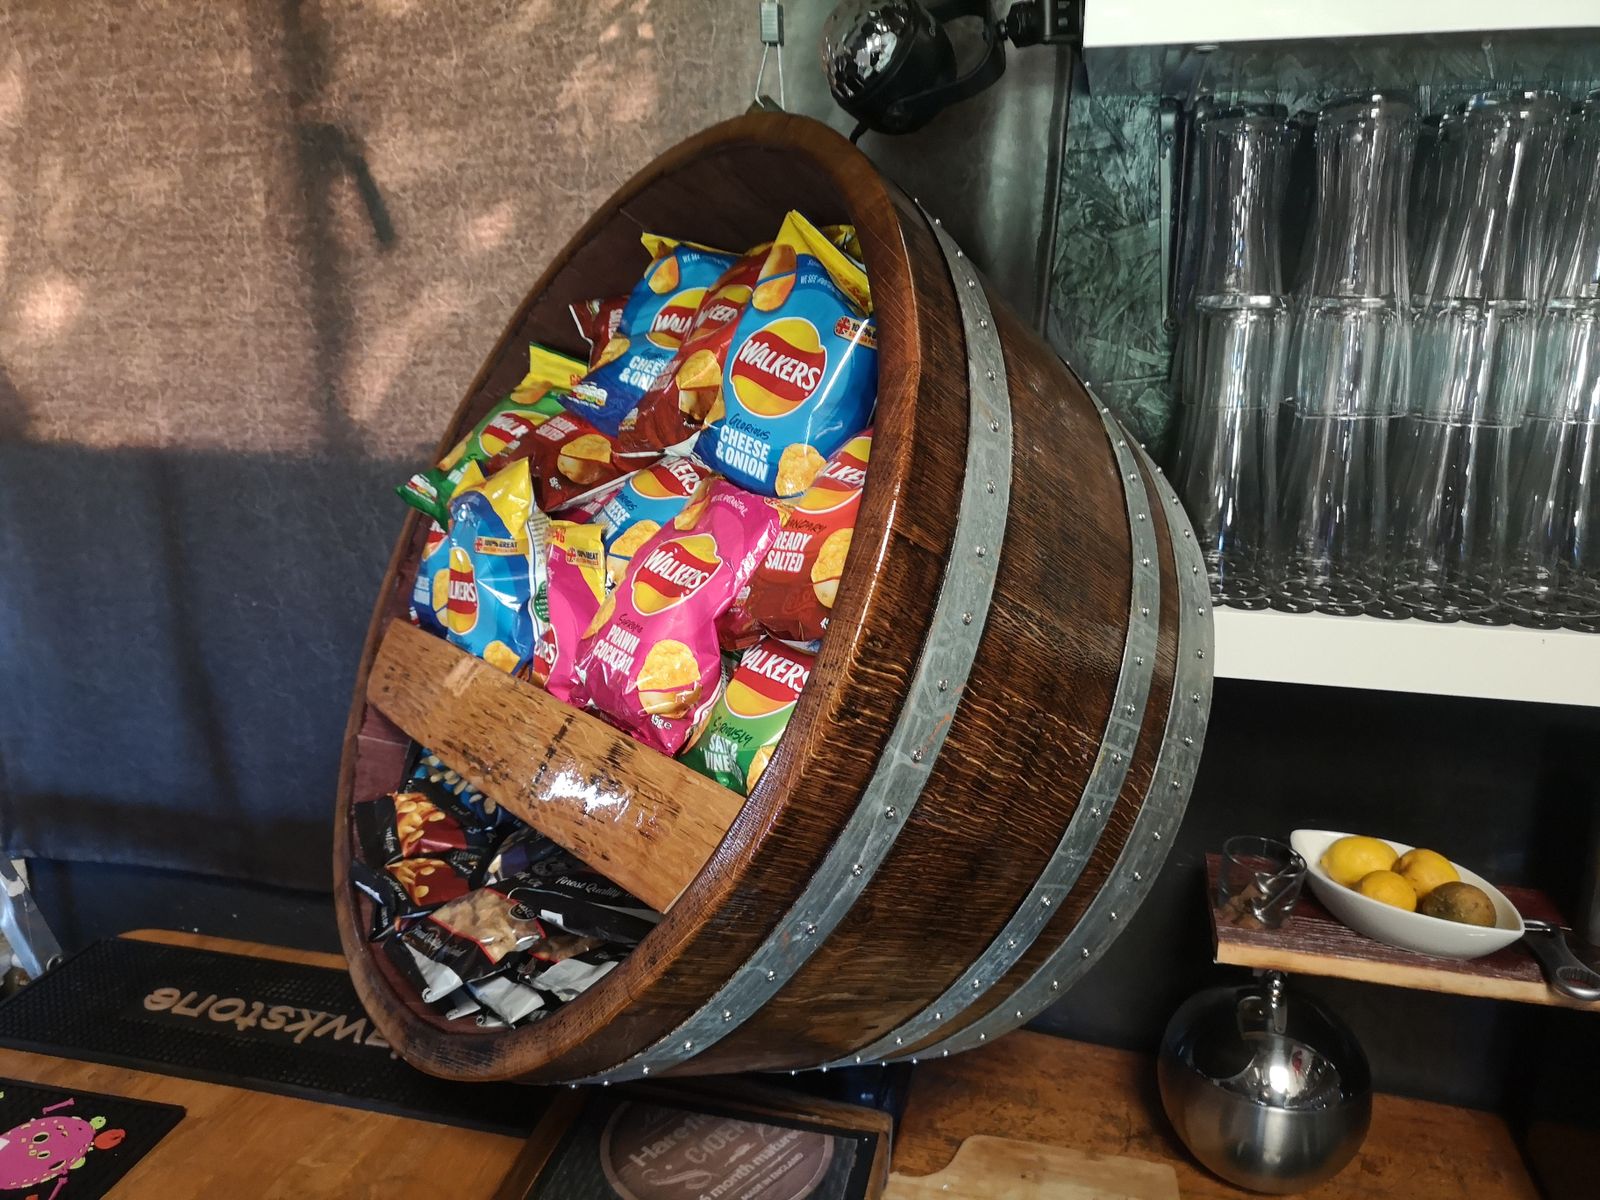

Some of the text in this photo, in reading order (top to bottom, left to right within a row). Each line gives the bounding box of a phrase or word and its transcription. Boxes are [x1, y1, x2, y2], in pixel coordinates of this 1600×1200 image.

[738, 339, 821, 391] WALKERS
[720, 424, 771, 462] CHEESE
[715, 440, 768, 483] & ONION
[773, 531, 812, 551] READY
[643, 548, 710, 590] WALKERS
[764, 550, 804, 573] SALTED
[605, 624, 640, 655] PRAWN
[592, 639, 635, 676] COCKTAIL
[708, 734, 731, 753] SALT
[584, 882, 620, 898] Quality
[710, 1163, 752, 1197] month
[753, 1130, 801, 1167] mature
[770, 1152, 804, 1182] ENGLAND
